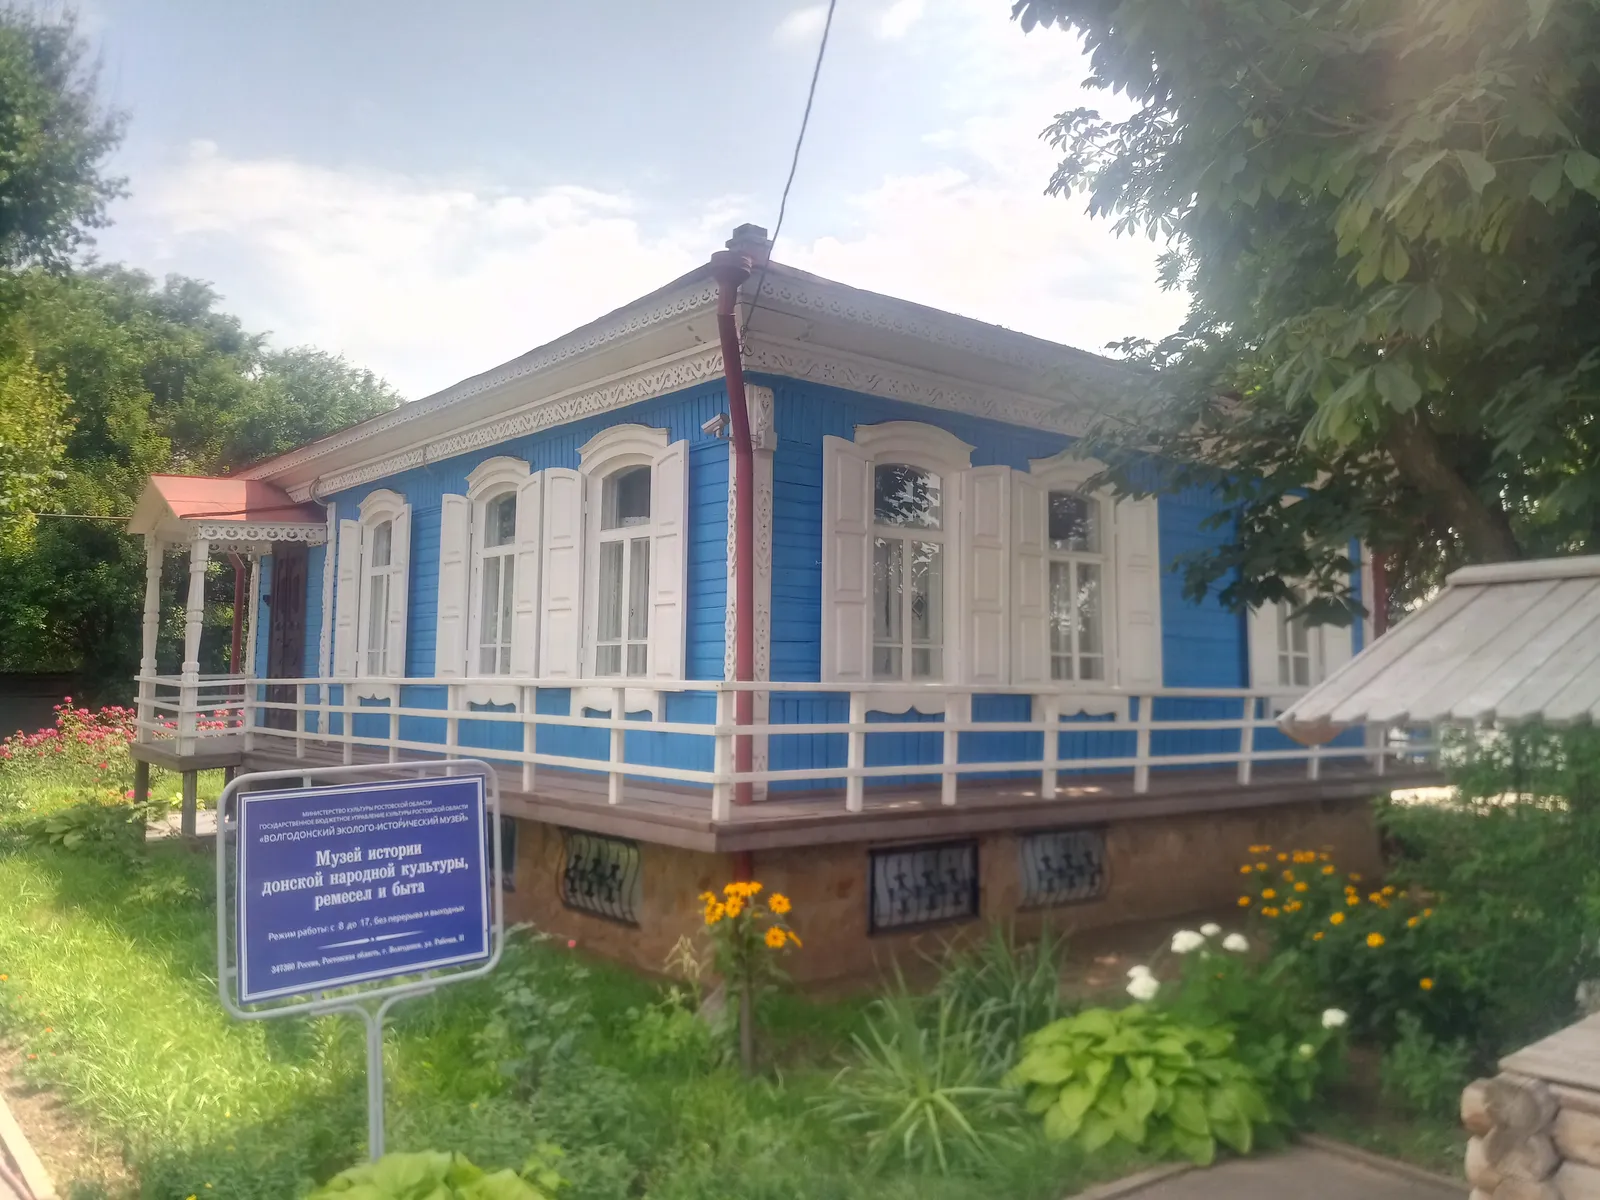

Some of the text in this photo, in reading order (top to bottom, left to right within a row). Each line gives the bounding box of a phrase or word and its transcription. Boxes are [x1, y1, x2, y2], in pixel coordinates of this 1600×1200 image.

[260, 818, 314, 830] ГОСУДАРСТВЕННОЕ
[315, 816, 350, 825] БЮДЖЕТНОЕ
[385, 808, 411, 817] КУЛЬТУРЫ
[412, 805, 445, 814] РОСТОВСКОЙ
[302, 799, 432, 817] МИНИСТЕРСТВО КУЛЬТУРЫ РОСТОВСКОЙ ОБЛАСТИ
[260, 812, 469, 843] «ВОЛГОДОНСКИЙ ЭКОЛОГО-ИСТОРИЧЕСКИЙ МУЗЕЙ»
[315, 844, 422, 868] Музей истории
[262, 857, 469, 897] донской народной культуры,
[315, 880, 425, 911] ремесел и быта
[268, 930, 296, 941] Режим
[297, 925, 329, 939] работы:
[330, 924, 335, 932] с
[338, 921, 344, 931] 8
[346, 921, 357, 930] до
[360, 917, 373, 927] 17,
[374, 915, 387, 925] без
[388, 911, 423, 924] перерыва
[430, 905, 465, 917] выходных
